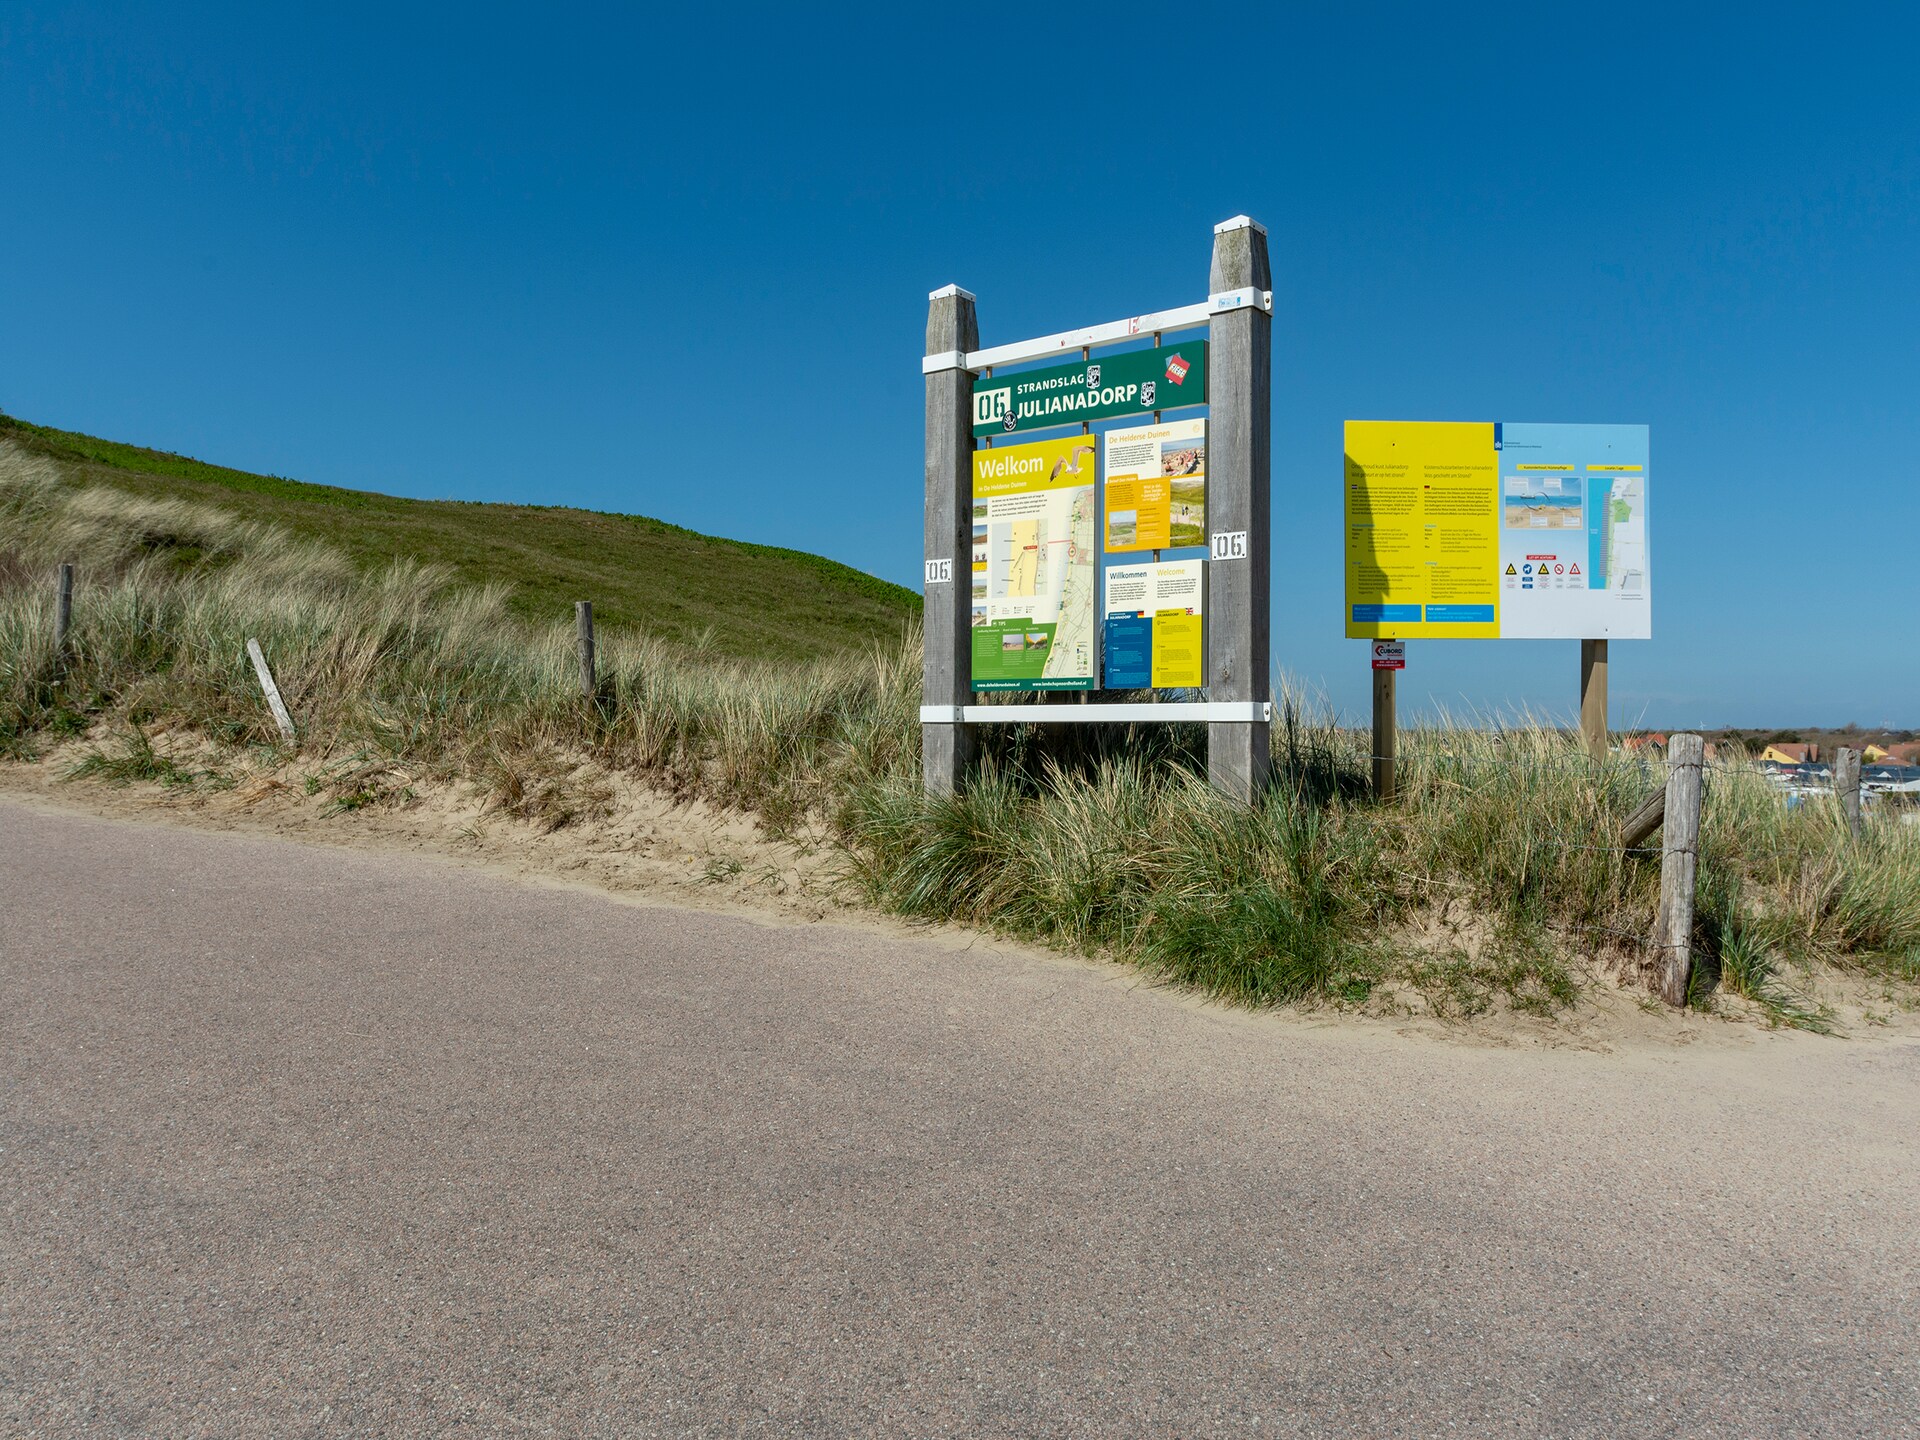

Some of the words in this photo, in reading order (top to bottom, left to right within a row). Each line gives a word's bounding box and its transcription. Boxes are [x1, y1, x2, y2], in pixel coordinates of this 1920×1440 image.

[1017, 373, 1085, 395] STRANDSLAG
[978, 392, 1005, 421] 06
[1017, 384, 1138, 420] JULIANADORP
[1109, 436, 1118, 444] De
[1119, 434, 1146, 443] Helderse
[1147, 430, 1171, 439] Duinen
[978, 455, 1044, 479] Welkom
[1217, 534, 1242, 557] 06
[930, 562, 948, 580] 06
[1109, 571, 1148, 579] Willkommen
[1156, 568, 1185, 577] Welcome
